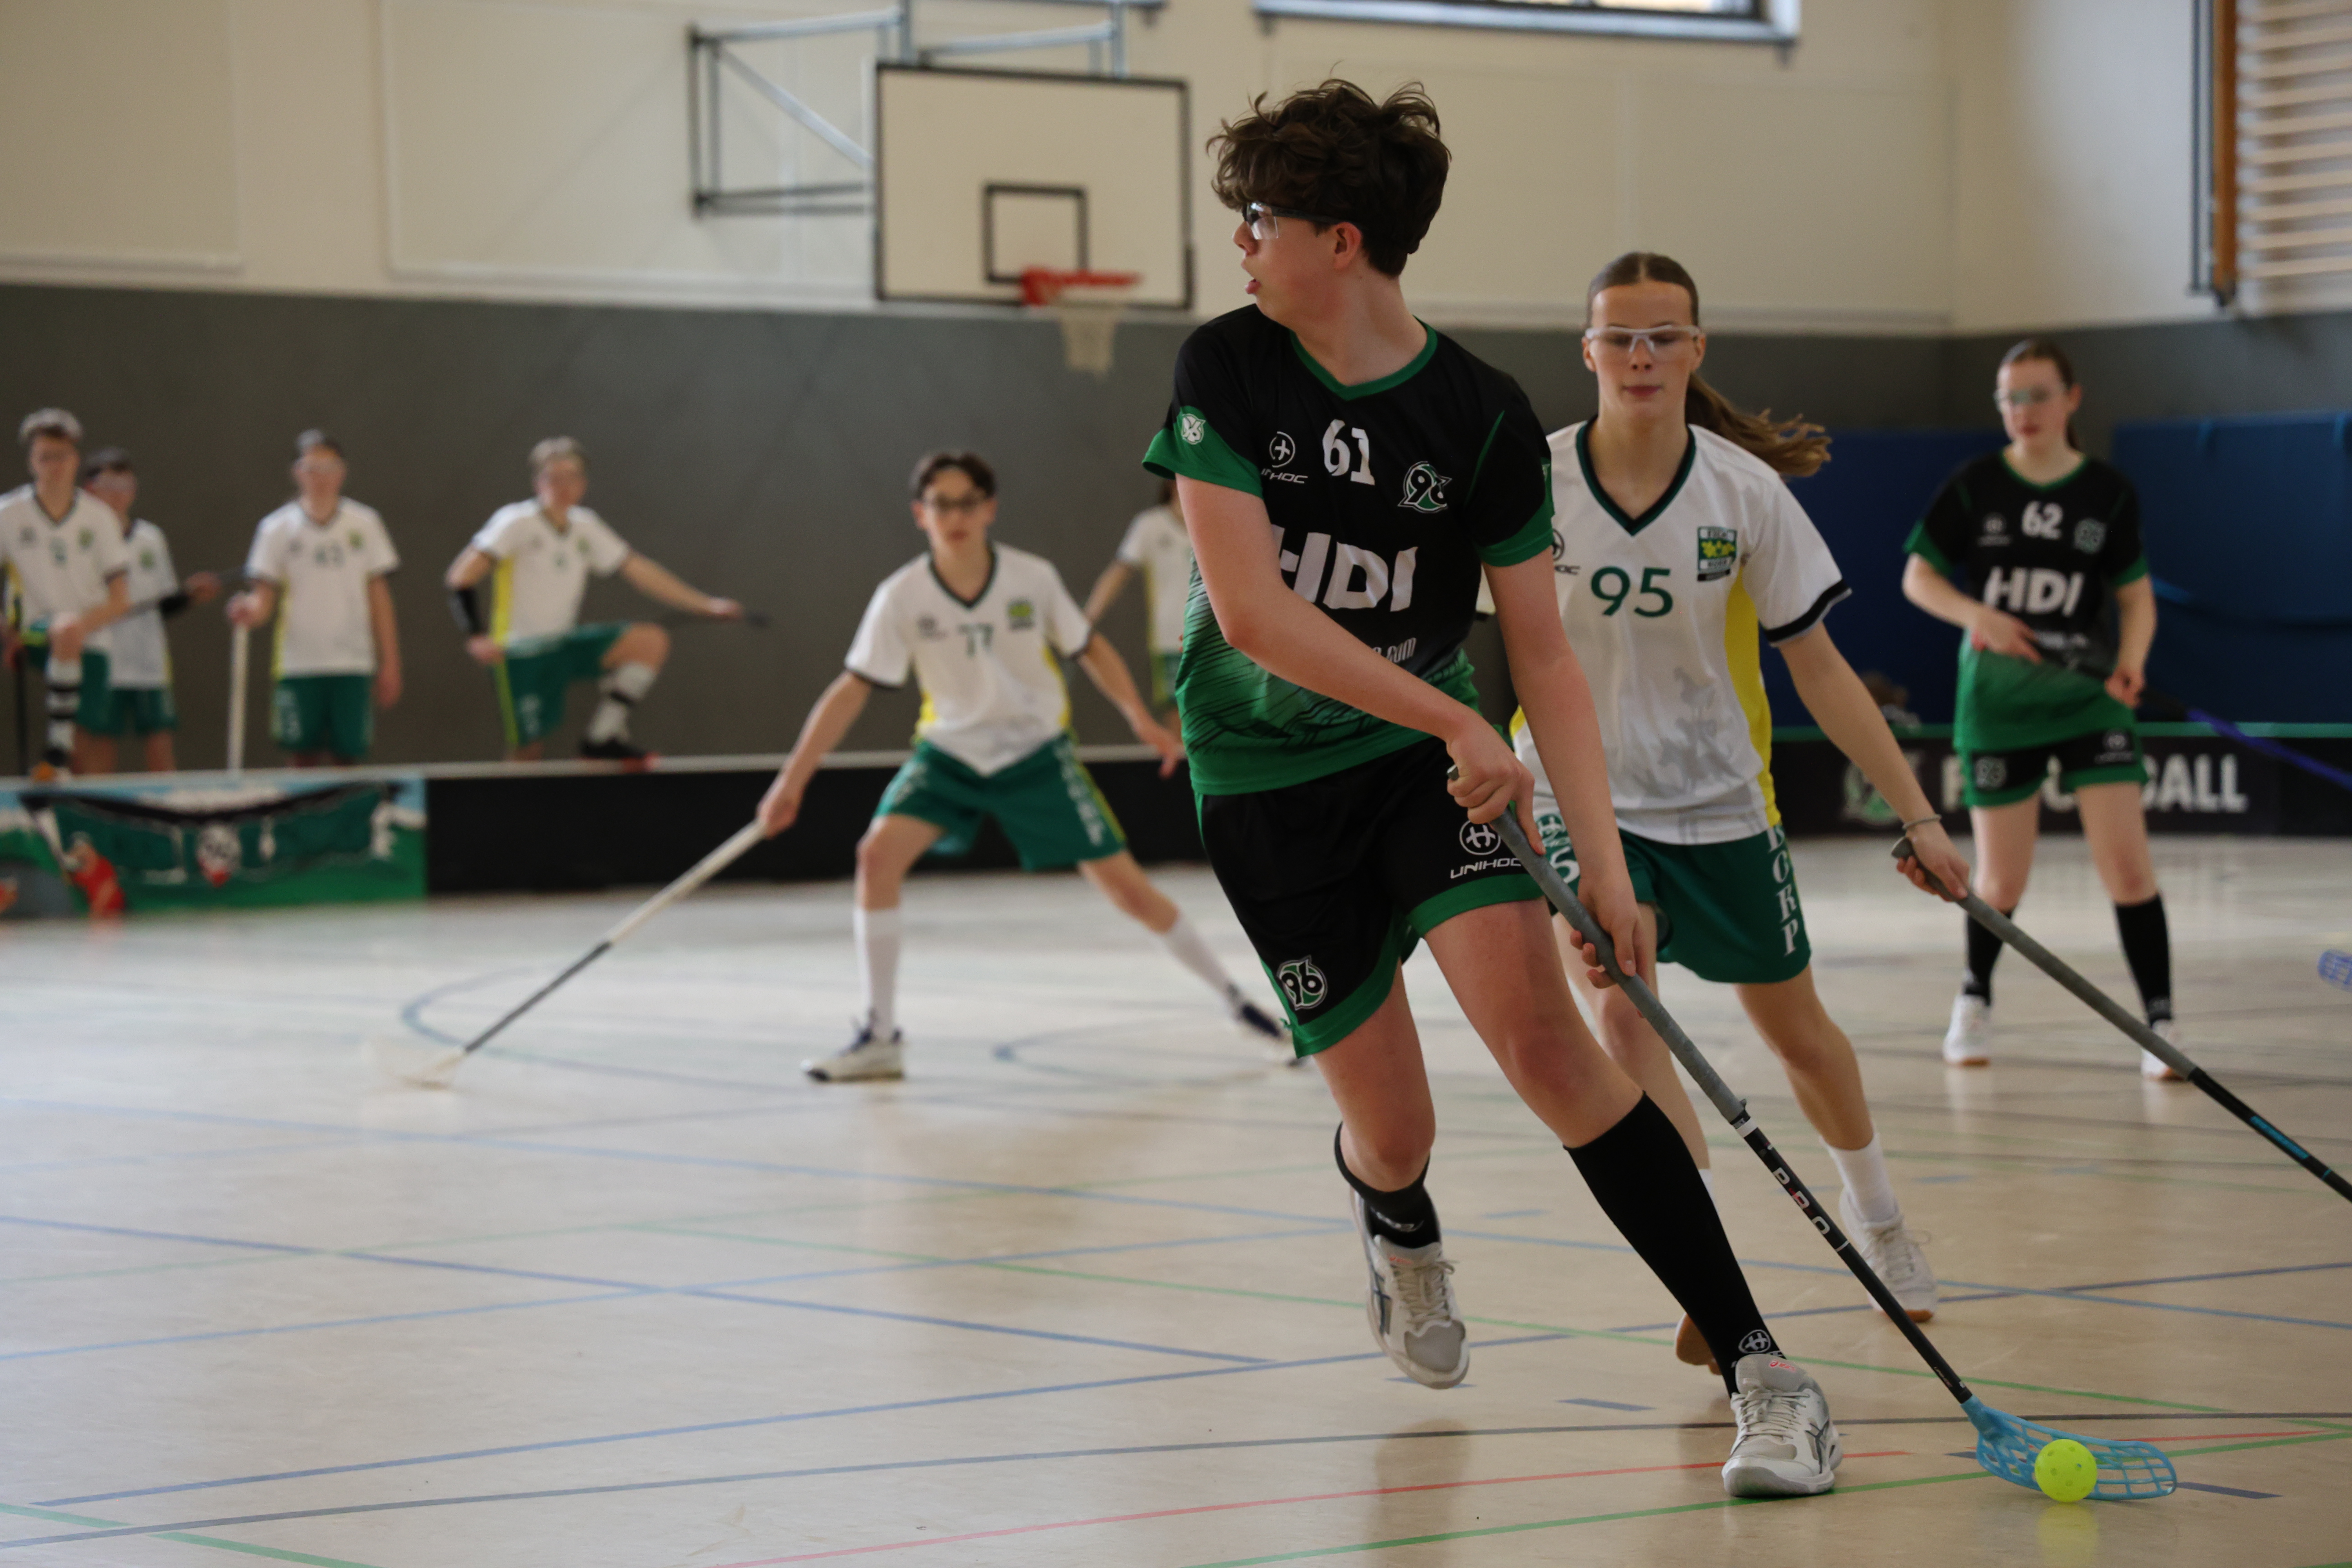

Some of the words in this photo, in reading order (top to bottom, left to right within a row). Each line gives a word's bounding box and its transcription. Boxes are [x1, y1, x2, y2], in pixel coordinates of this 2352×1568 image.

[1322, 419, 1375, 485] 61
[2022, 501, 2063, 540] 62
[1271, 524, 1418, 612] HDI
[1591, 566, 1673, 617] 95
[1984, 566, 2085, 617] HDI
[1450, 858, 1521, 879] UNIHOC
